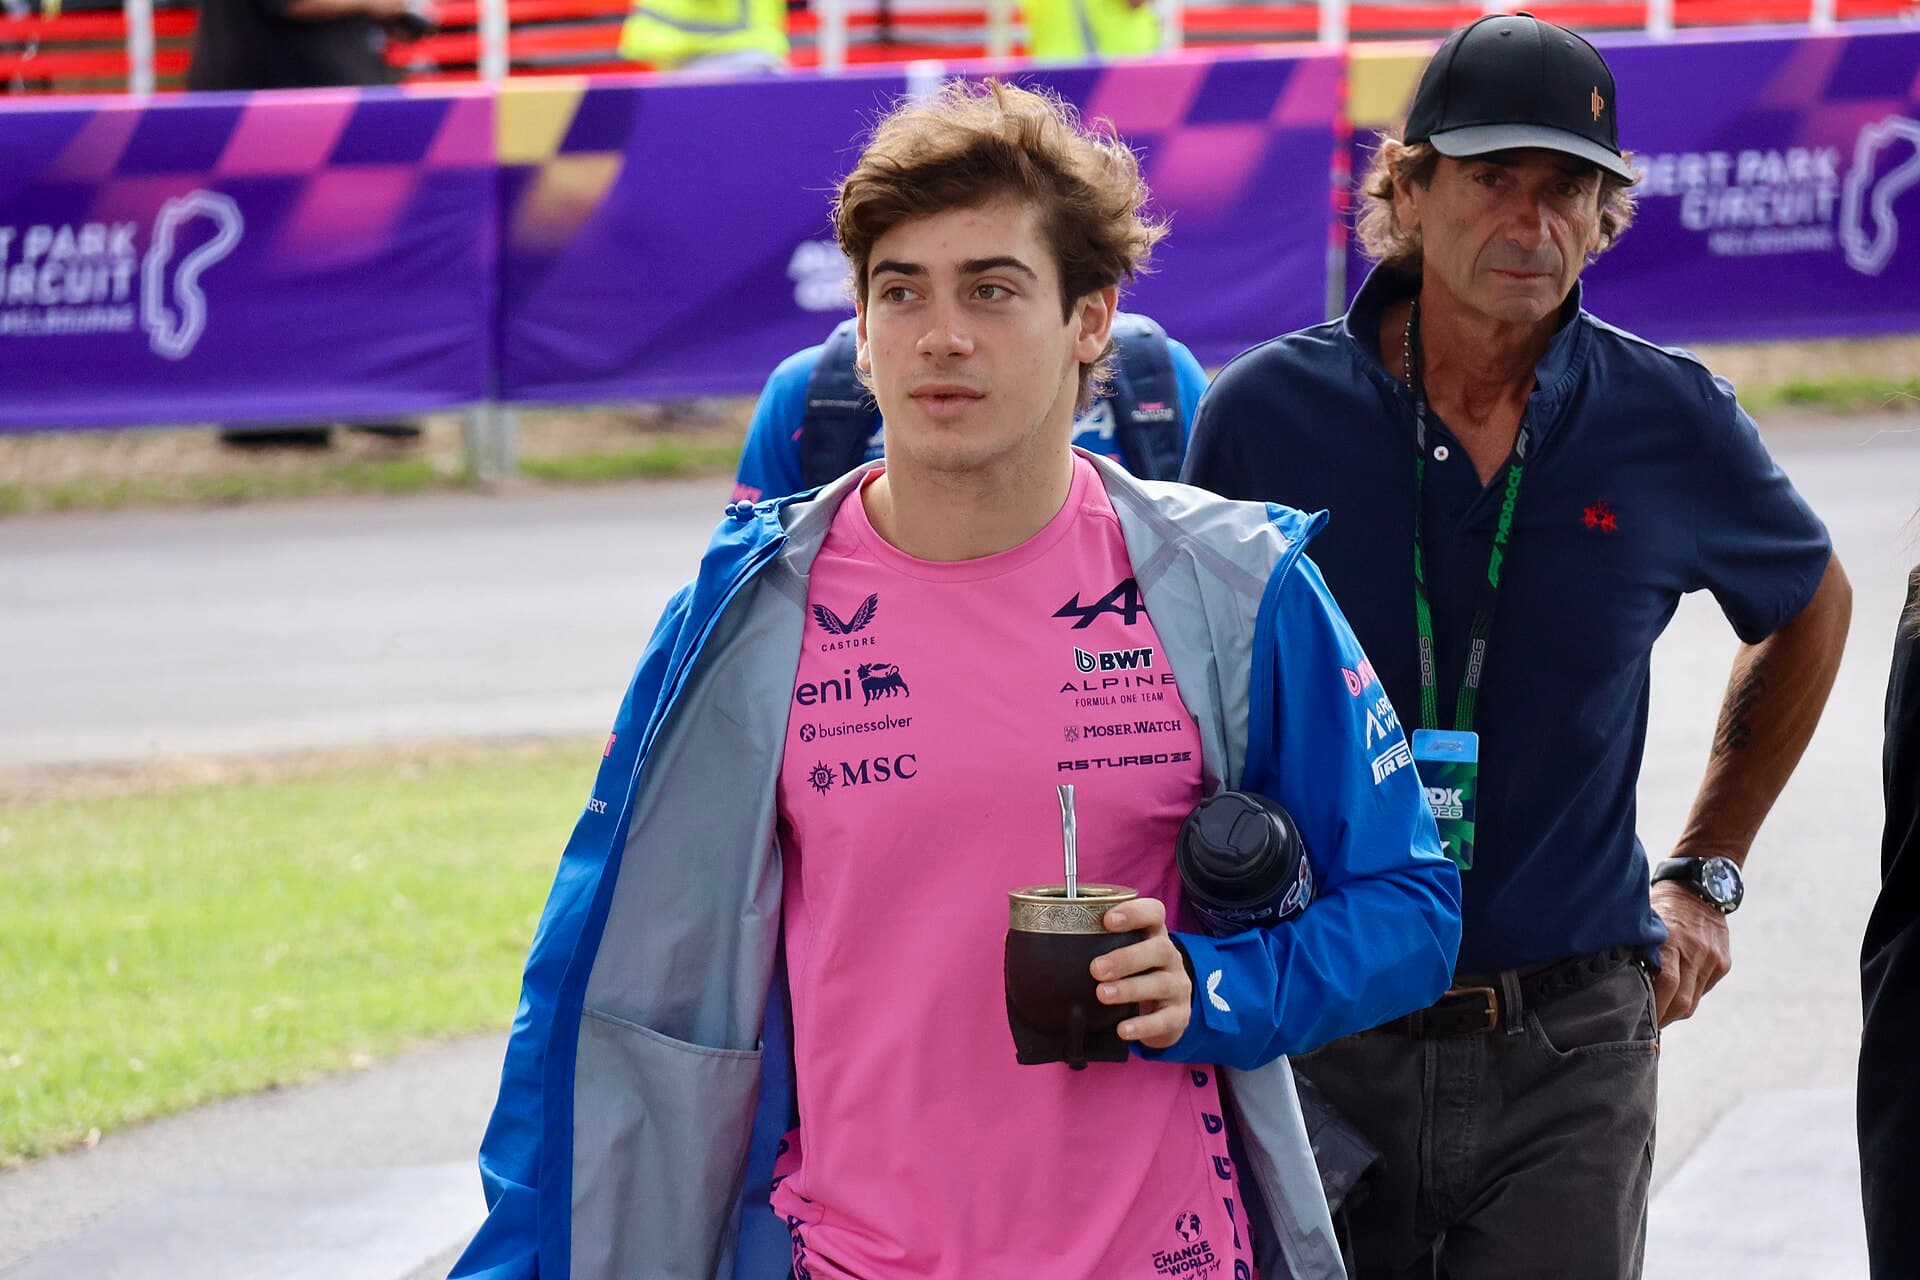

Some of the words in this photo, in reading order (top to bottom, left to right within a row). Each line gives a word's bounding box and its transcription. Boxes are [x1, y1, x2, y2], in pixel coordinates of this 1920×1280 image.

[1737, 147, 1840, 187] PARK
[1681, 184, 1838, 231] CIRCUIT
[23, 221, 137, 260] PARK
[1496, 464, 1523, 544] PADDOCK
[821, 636, 877, 652] CASTORE
[1098, 647, 1153, 672] BWT
[1419, 636, 1433, 687] 2026
[796, 669, 852, 706] eni
[1060, 673, 1176, 693] ALPINE
[1075, 695, 1117, 708] FORMULA
[1120, 694, 1137, 704] ONE
[1142, 692, 1164, 703] TEAM
[819, 714, 912, 738] businessolver
[840, 754, 917, 787] MSC
[1154, 1240, 1211, 1269] CHANGE
[1168, 1253, 1215, 1276] WORLD
